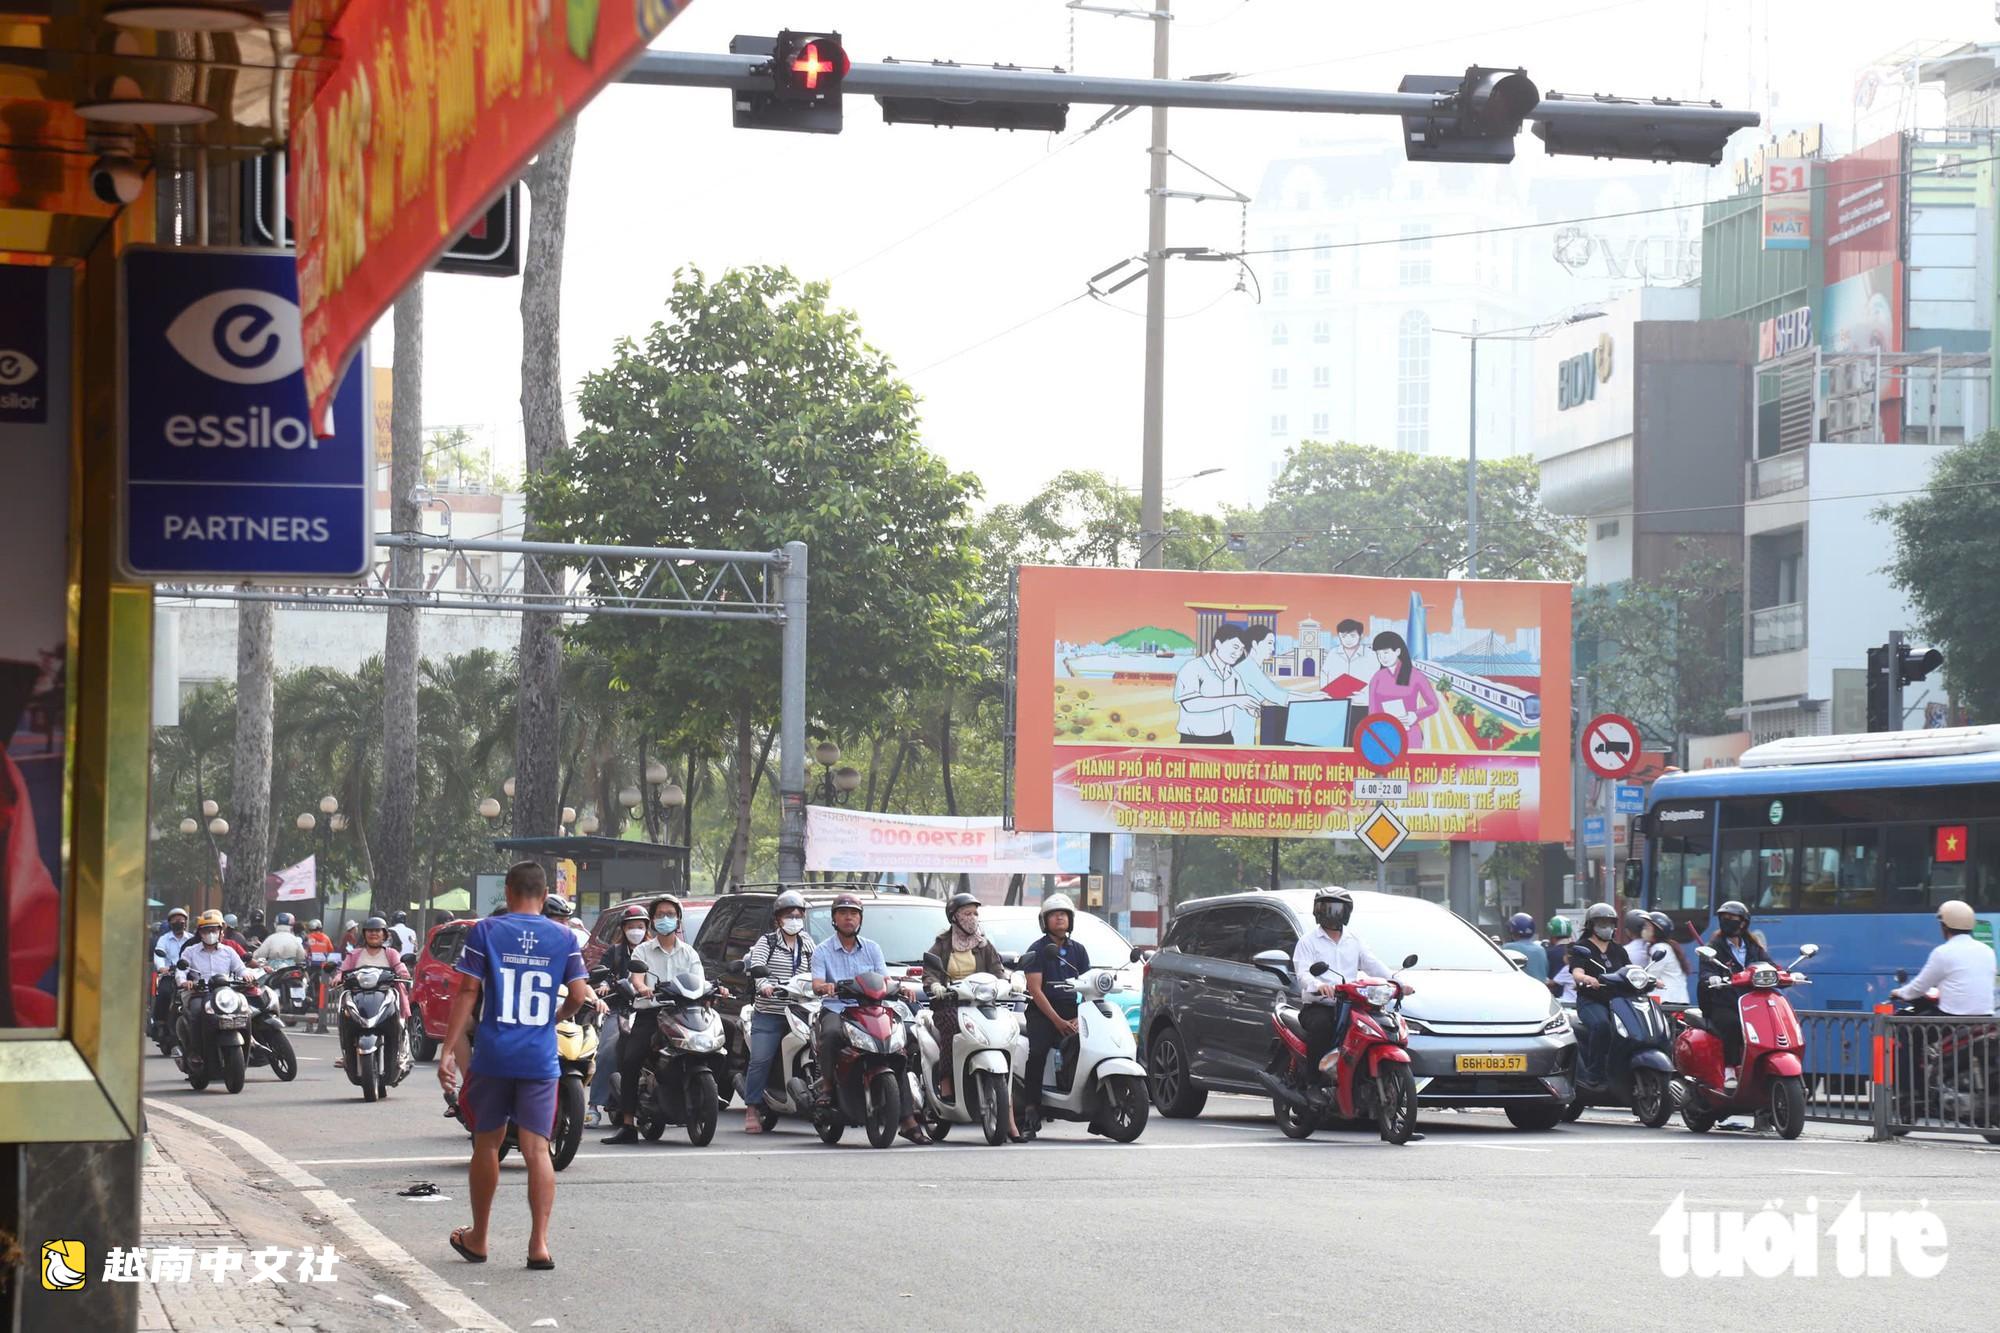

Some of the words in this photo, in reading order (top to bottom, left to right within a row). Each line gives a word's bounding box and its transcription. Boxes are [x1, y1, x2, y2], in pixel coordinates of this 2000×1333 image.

[1769, 166, 1806, 191] 51
[1776, 306, 1813, 357] SHB
[1558, 348, 1599, 411] BIDV
[164, 515, 330, 543] PARTNERS
[1076, 757, 1116, 777] THÀNH
[1119, 755, 1143, 778] PHỐ
[1166, 758, 1186, 779] CHÍ
[1189, 762, 1221, 780] MINH
[1224, 758, 1261, 781] QUYẾT
[1264, 761, 1290, 781] TÂM
[1414, 762, 1438, 785] CHỦ
[1459, 765, 1488, 786] NĂM
[1159, 783, 1192, 803] NÂNG
[1195, 786, 1219, 804] CAO
[1222, 782, 1252, 805] CHẤT
[1315, 785, 1347, 806] CHỨC
[1432, 790, 1470, 809] THÔNG
[1231, 809, 1265, 829] NÂNG
[1268, 812, 1292, 830] CAO
[529, 958, 550, 967] QUALITY
[497, 967, 553, 1026] 16
